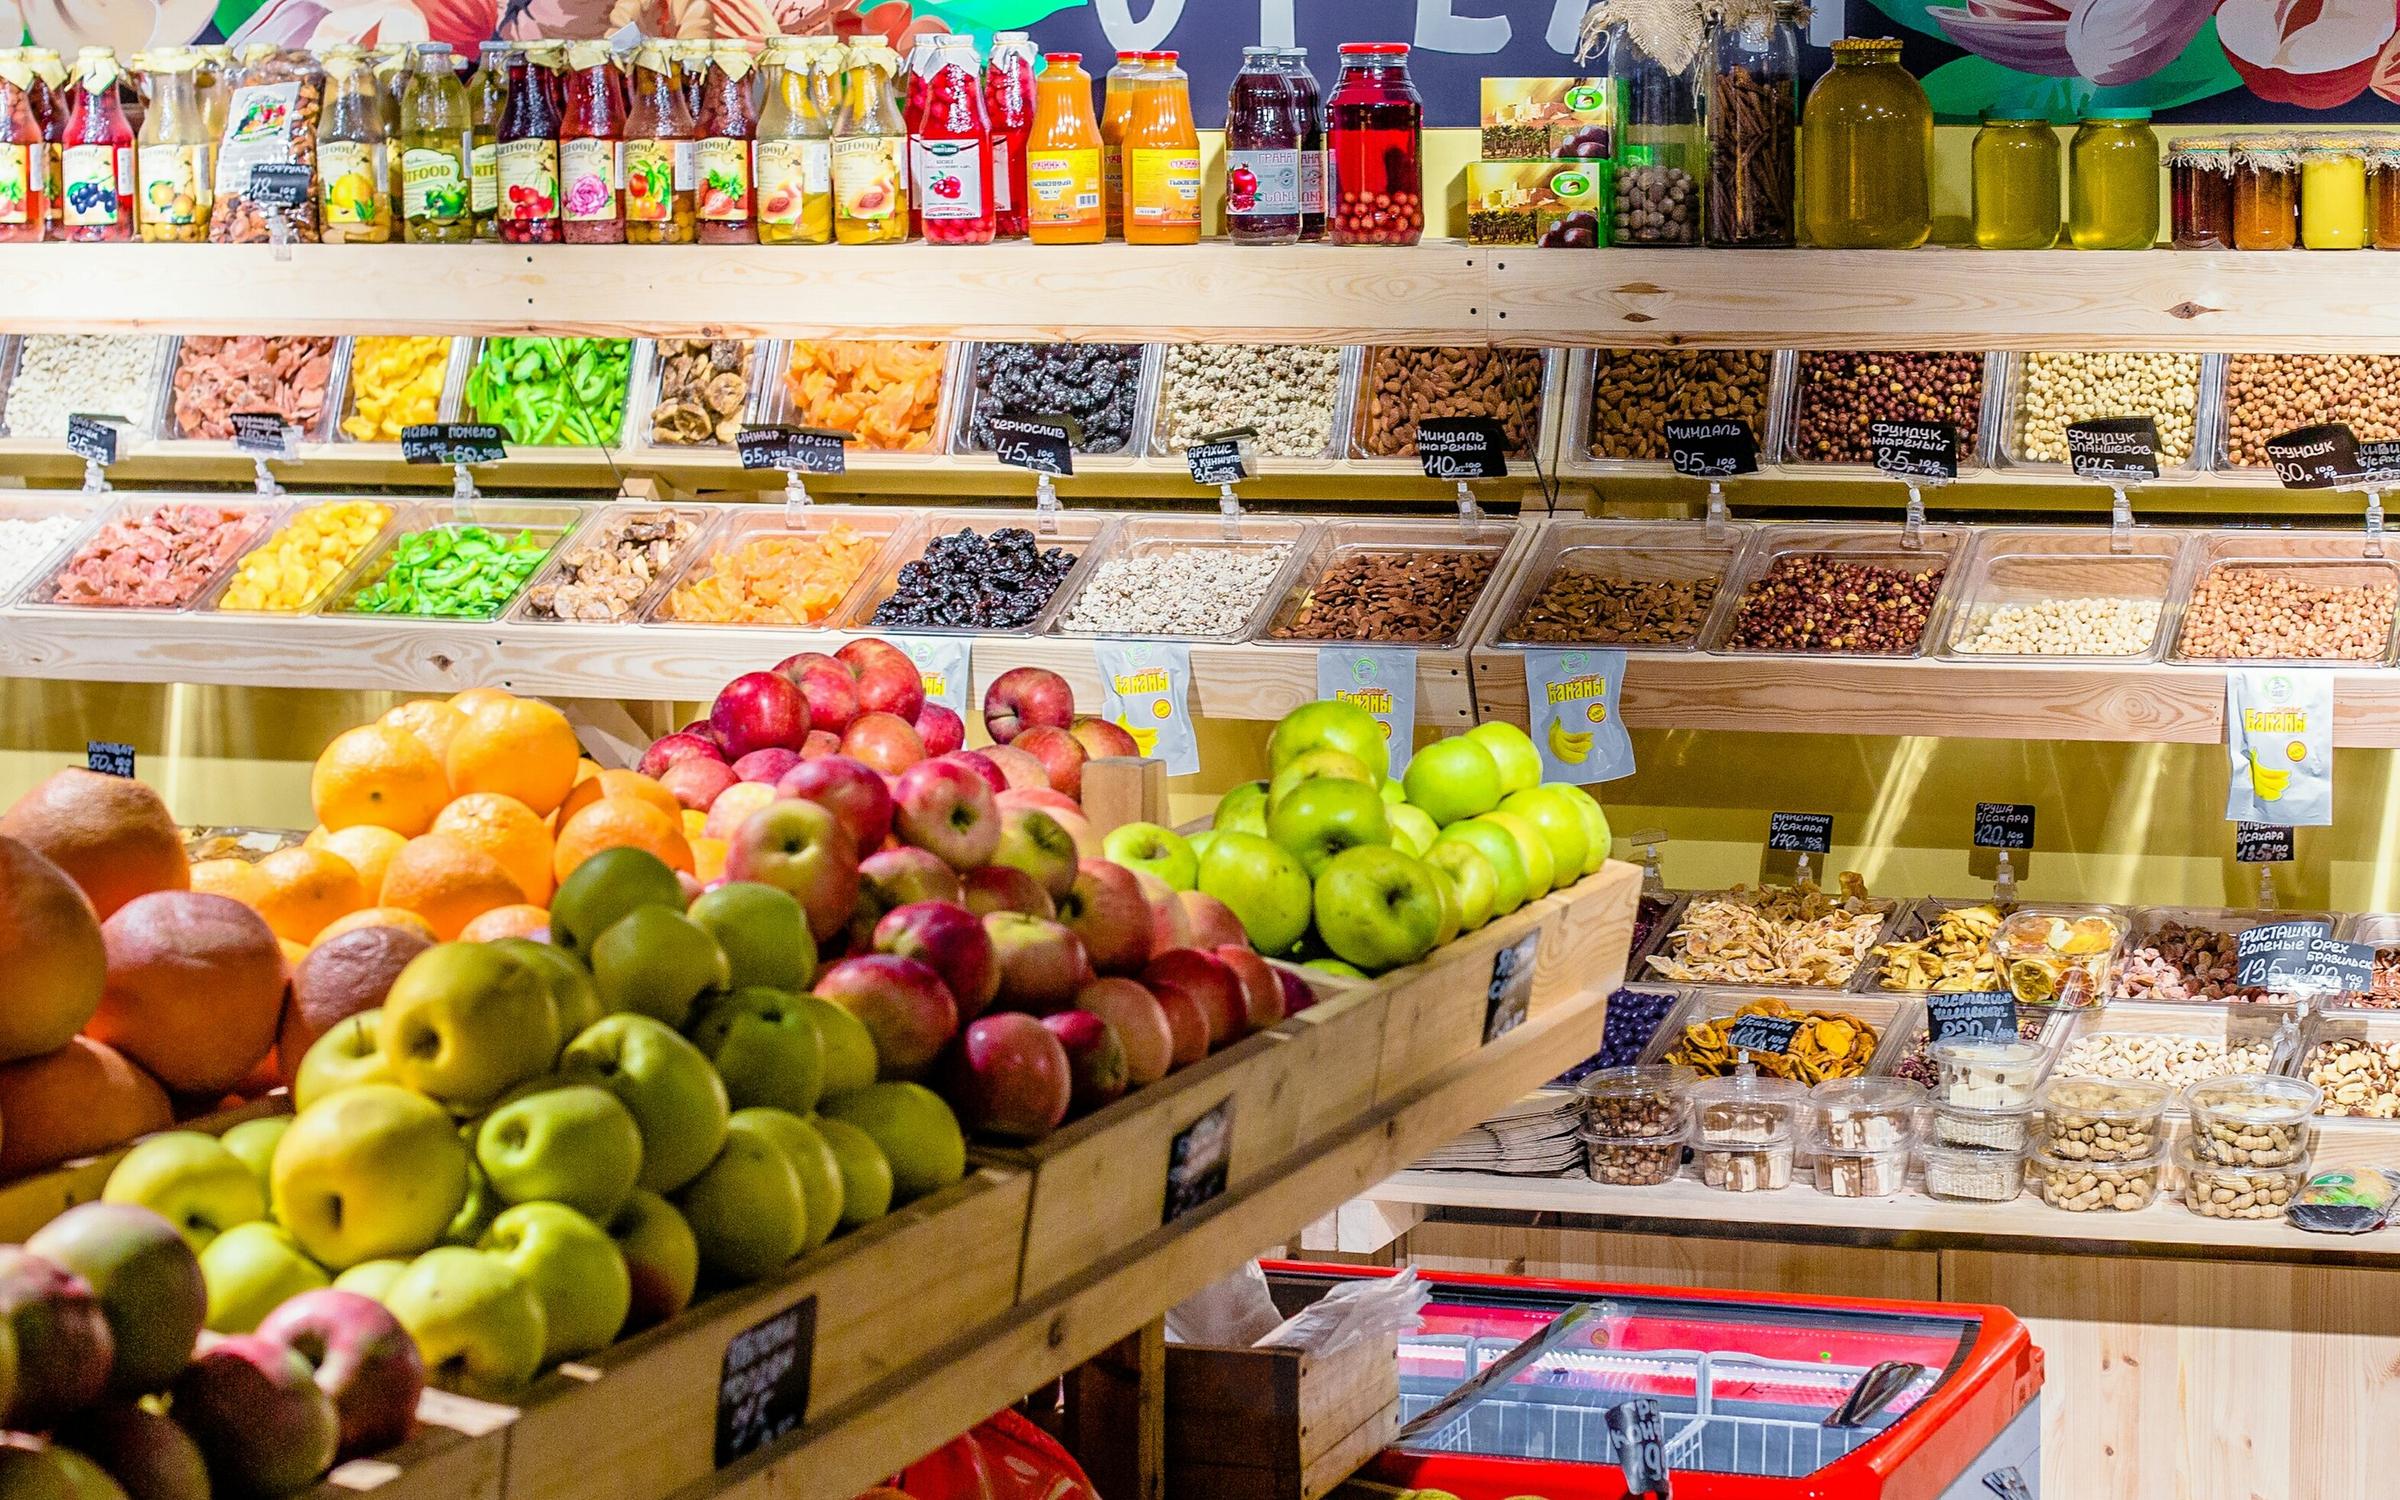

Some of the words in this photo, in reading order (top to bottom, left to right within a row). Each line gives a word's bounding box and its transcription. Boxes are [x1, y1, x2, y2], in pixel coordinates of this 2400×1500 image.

[1257, 152, 1297, 164] ГРАНАТ
[989, 418, 1067, 440] ЧЕРНОСЛИВ
[1667, 425, 1742, 440] МИНДАЛЬ
[1872, 423, 1942, 441] ФУНДУК
[737, 430, 780, 443] ИНЖИР
[1417, 430, 1485, 444] МИНДАЛЬ
[2068, 429, 2137, 446] ФУНДУК
[1036, 449, 1055, 458] 100
[1188, 444, 1233, 459] АРАХИС
[2267, 441, 2336, 459] ФУНДУК
[1188, 458, 1198, 469] В
[1716, 457, 1736, 467] 100
[2123, 463, 2145, 471] 100
[2315, 465, 2335, 475] 100
[1546, 677, 1607, 706] Бананы
[1773, 813, 1831, 825] МАНДАРИН
[2239, 924, 2324, 945] ФИСТАШКИ
[2344, 971, 2364, 983] 100
